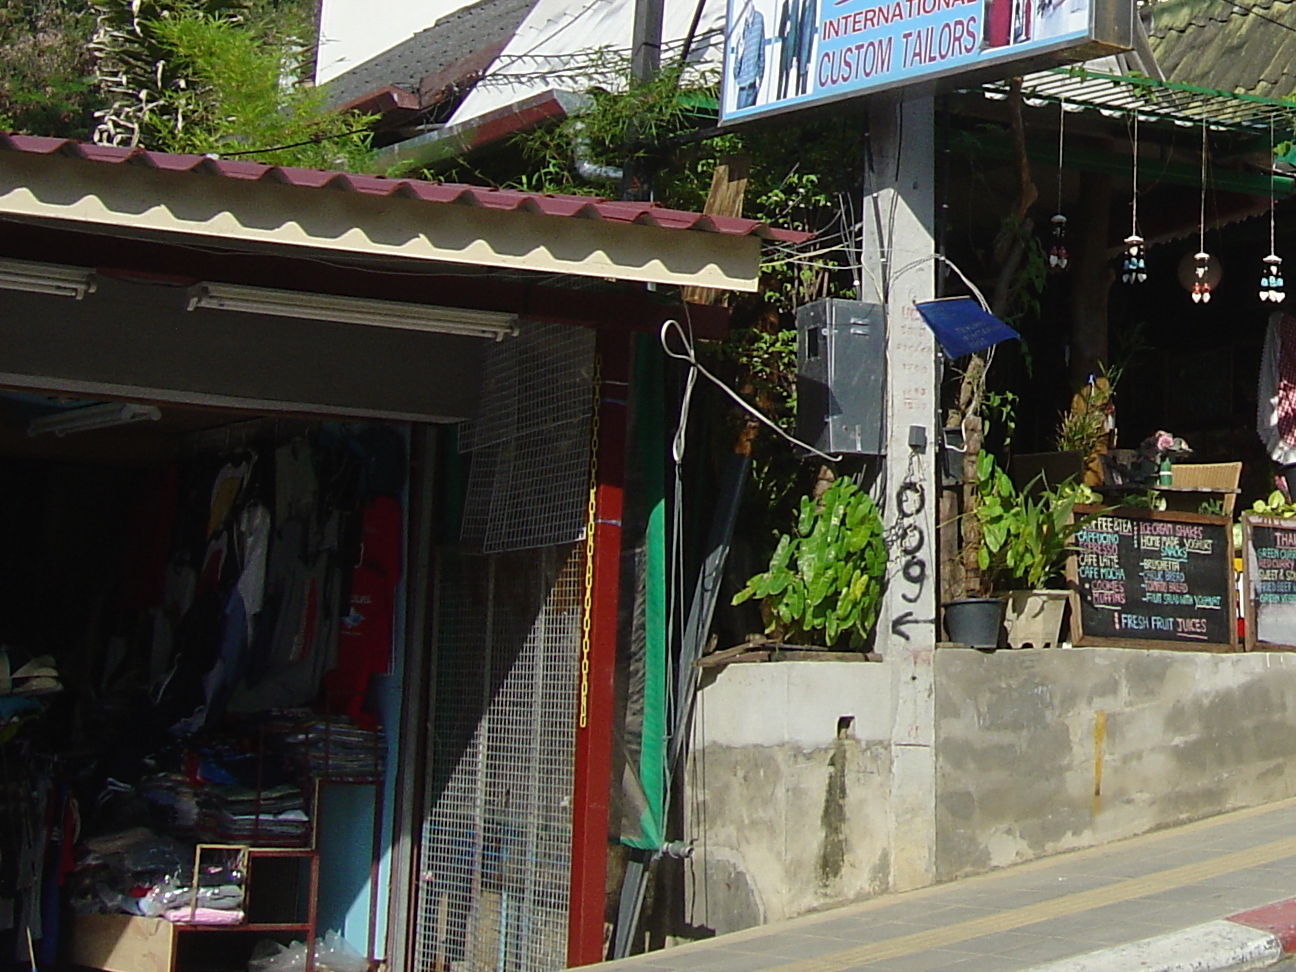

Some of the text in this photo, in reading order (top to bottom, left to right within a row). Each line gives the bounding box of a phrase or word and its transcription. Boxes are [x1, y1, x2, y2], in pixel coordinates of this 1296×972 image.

[818, 15, 978, 88] CUSTOM TAILORS
[1175, 524, 1203, 539] SHAKES
[1141, 535, 1160, 548] HOME
[1274, 532, 1296, 546] THAI
[1079, 553, 1098, 566] CAFE
[1257, 547, 1279, 559] GREEN
[1258, 558, 1272, 568] RED
[1079, 566, 1126, 580] CAFE MOCHA
[1092, 592, 1127, 604] MUFFINS
[1121, 613, 1207, 632] FRESH FRUIT JUICES
